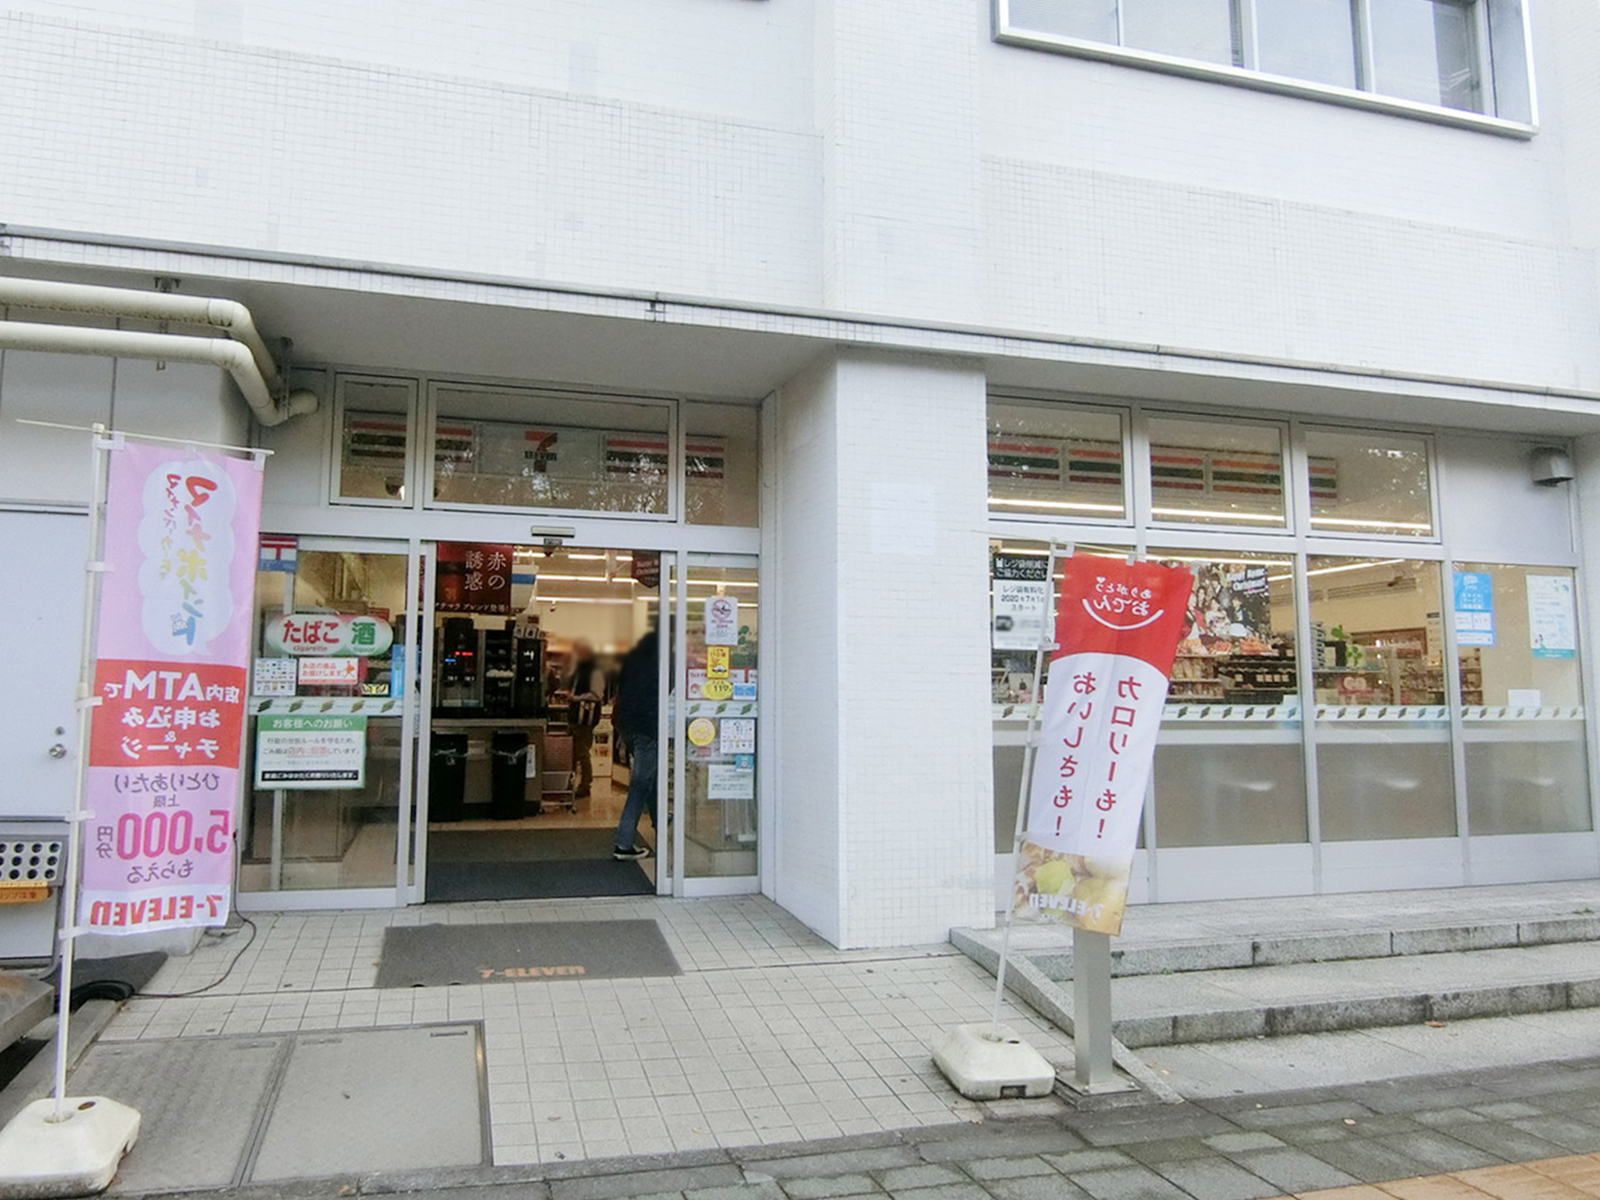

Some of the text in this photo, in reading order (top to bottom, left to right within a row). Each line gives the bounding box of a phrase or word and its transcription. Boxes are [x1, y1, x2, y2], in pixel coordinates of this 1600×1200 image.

[464, 550, 484, 591] 誘惑
[487, 551, 507, 590] 赤の
[282, 620, 340, 644] たばこ
[351, 622, 377, 646] 酒
[272, 718, 353, 729] お客様へのお願い
